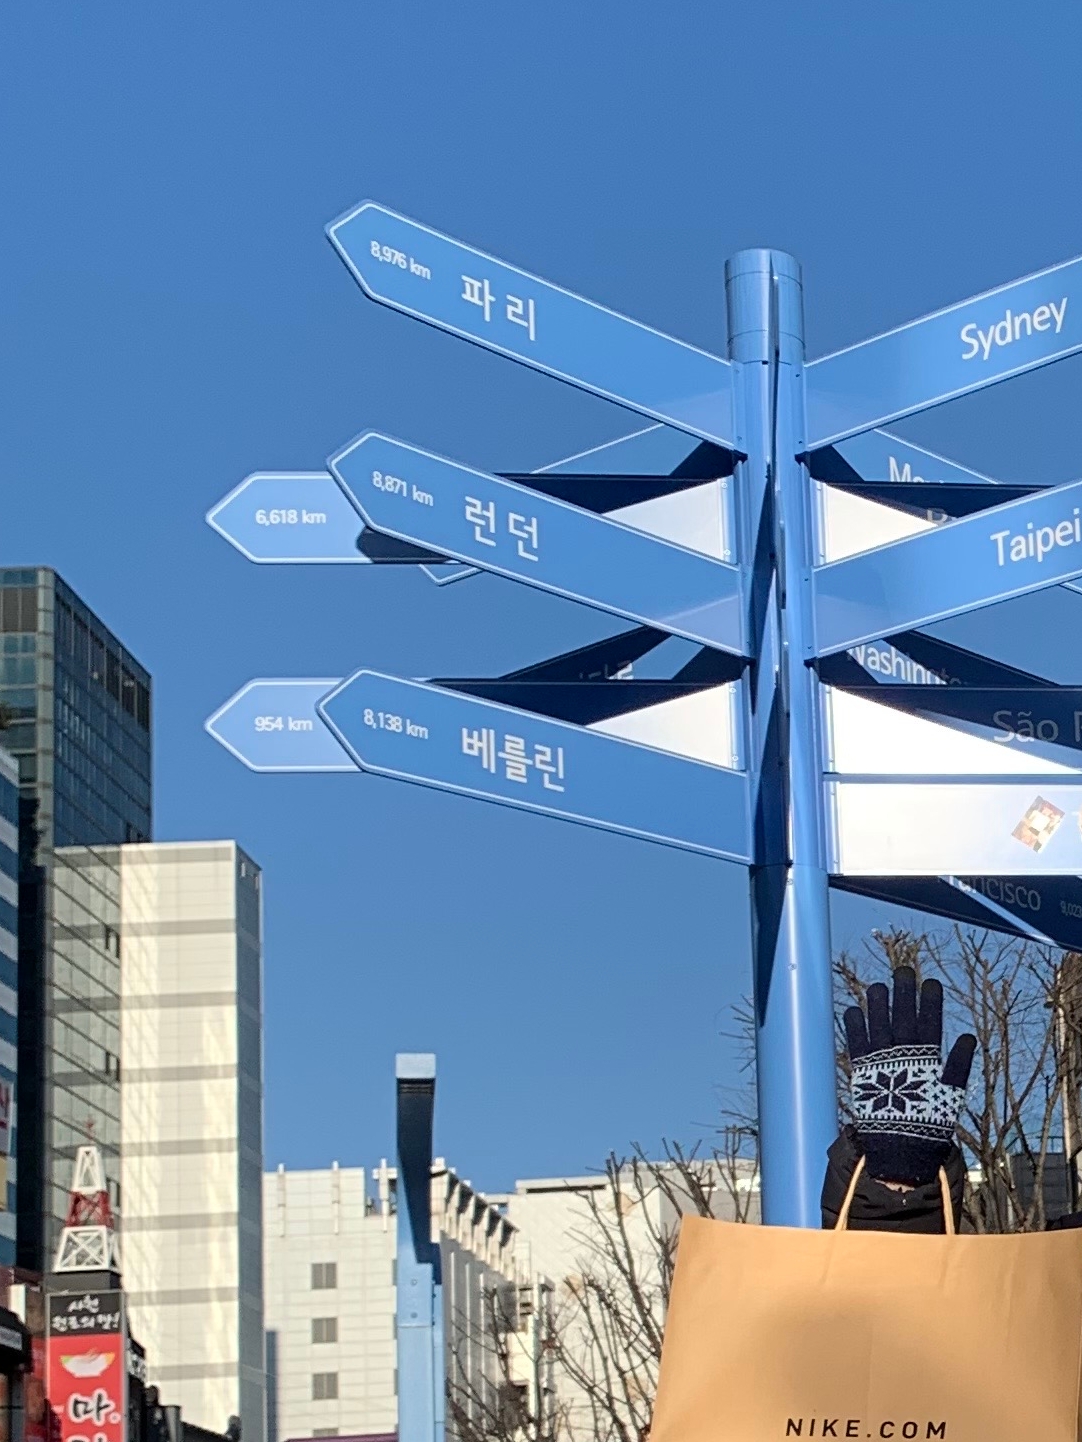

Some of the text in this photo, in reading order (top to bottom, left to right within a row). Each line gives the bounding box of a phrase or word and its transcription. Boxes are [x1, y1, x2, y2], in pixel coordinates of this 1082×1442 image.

[369, 240, 431, 280] 8,976 km
[960, 297, 1068, 360] Sydney
[372, 471, 434, 507] 8,871 km
[255, 509, 327, 527] 6,618 km
[990, 508, 1082, 567] Taipei
[255, 715, 313, 732] 954 km
[363, 708, 429, 740] 8,138 km
[992, 709, 1059, 743] São
[460, 727, 565, 793] 베를린
[785, 1418, 947, 1440] NIKE.COM
